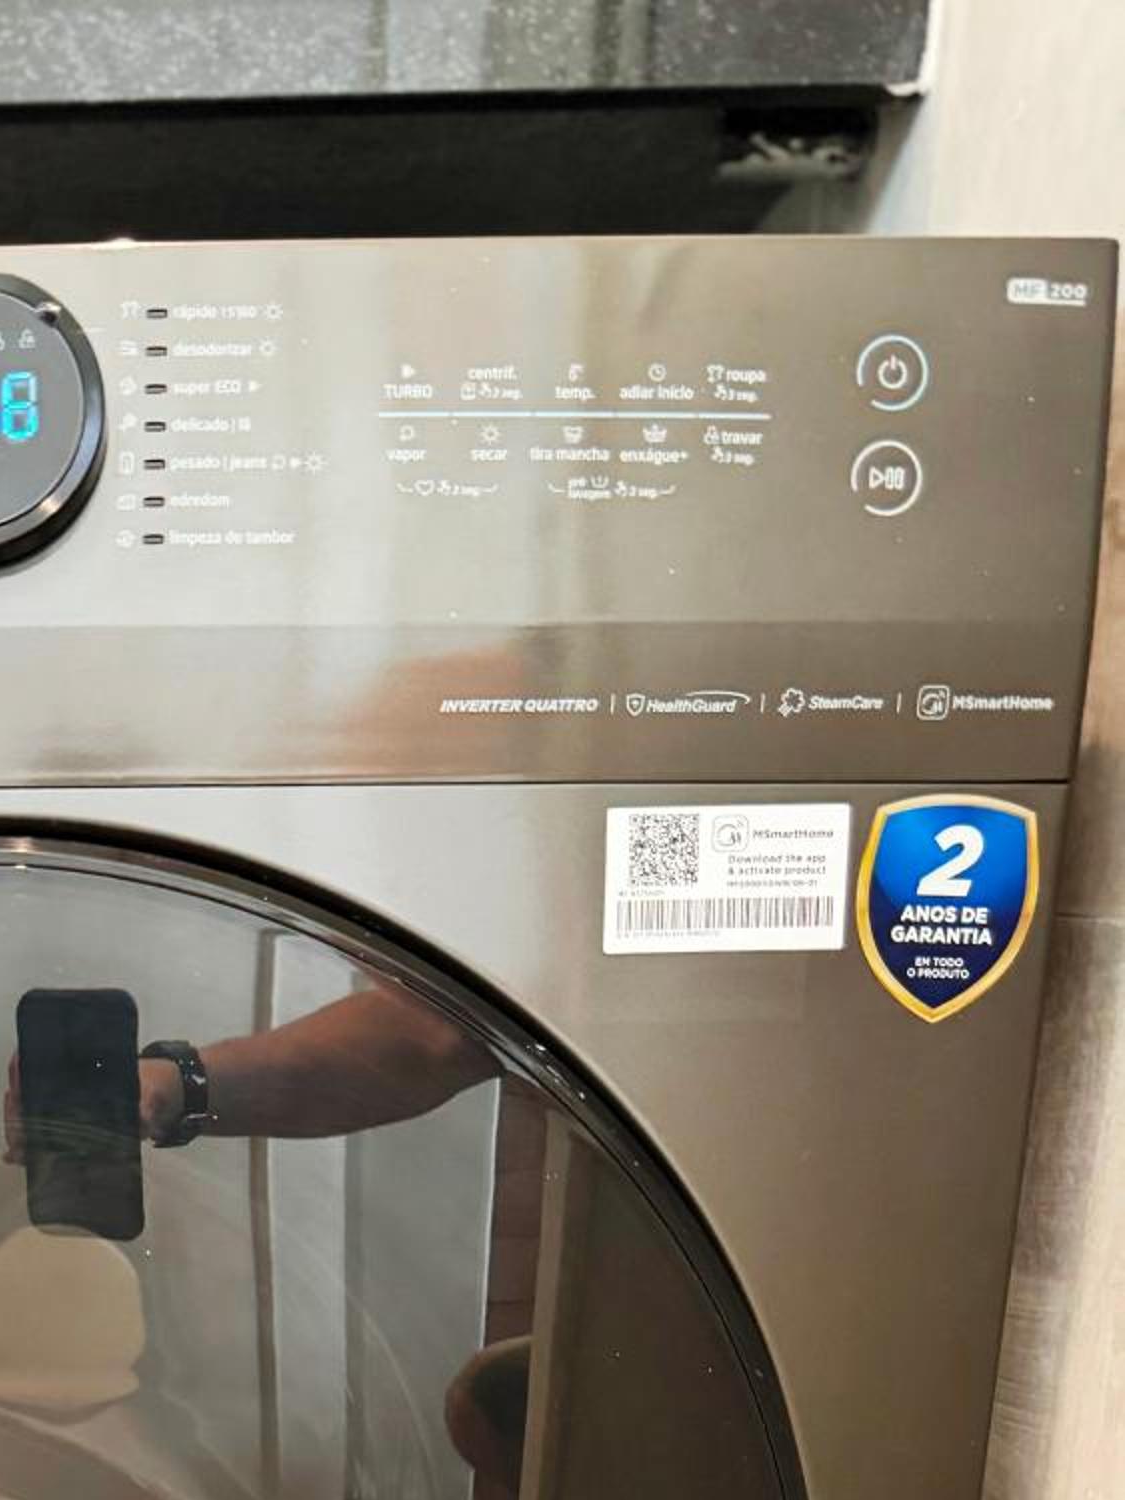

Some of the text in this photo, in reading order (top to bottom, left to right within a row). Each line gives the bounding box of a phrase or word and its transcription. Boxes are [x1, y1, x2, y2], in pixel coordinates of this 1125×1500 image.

[1050, 283, 1086, 299] 200
[726, 369, 766, 384] roupa
[215, 378, 242, 394] ECO
[383, 384, 433, 399] TURBO
[619, 385, 654, 400] adiar
[555, 386, 595, 402] temp.
[171, 417, 229, 433] delicado
[722, 430, 763, 445] travar
[386, 449, 427, 464] vapor
[470, 449, 507, 461] secar
[556, 447, 611, 462] mancha
[246, 529, 296, 544] tambor
[440, 699, 598, 713] INVERTER QUATTRO
[647, 699, 737, 713] HealthGuard
[808, 695, 883, 709] SteamCare
[952, 695, 1054, 710] MSmartHome
[752, 828, 834, 839] MSmartHome
[728, 855, 782, 864] Download
[806, 855, 826, 865] app
[917, 824, 984, 896] 2
[785, 865, 826, 876] product
[900, 904, 989, 925] ANOS DE
[890, 925, 993, 945] GARANTIA
[915, 956, 964, 967] EM TODO
[907, 967, 970, 979] O PRODUTO
